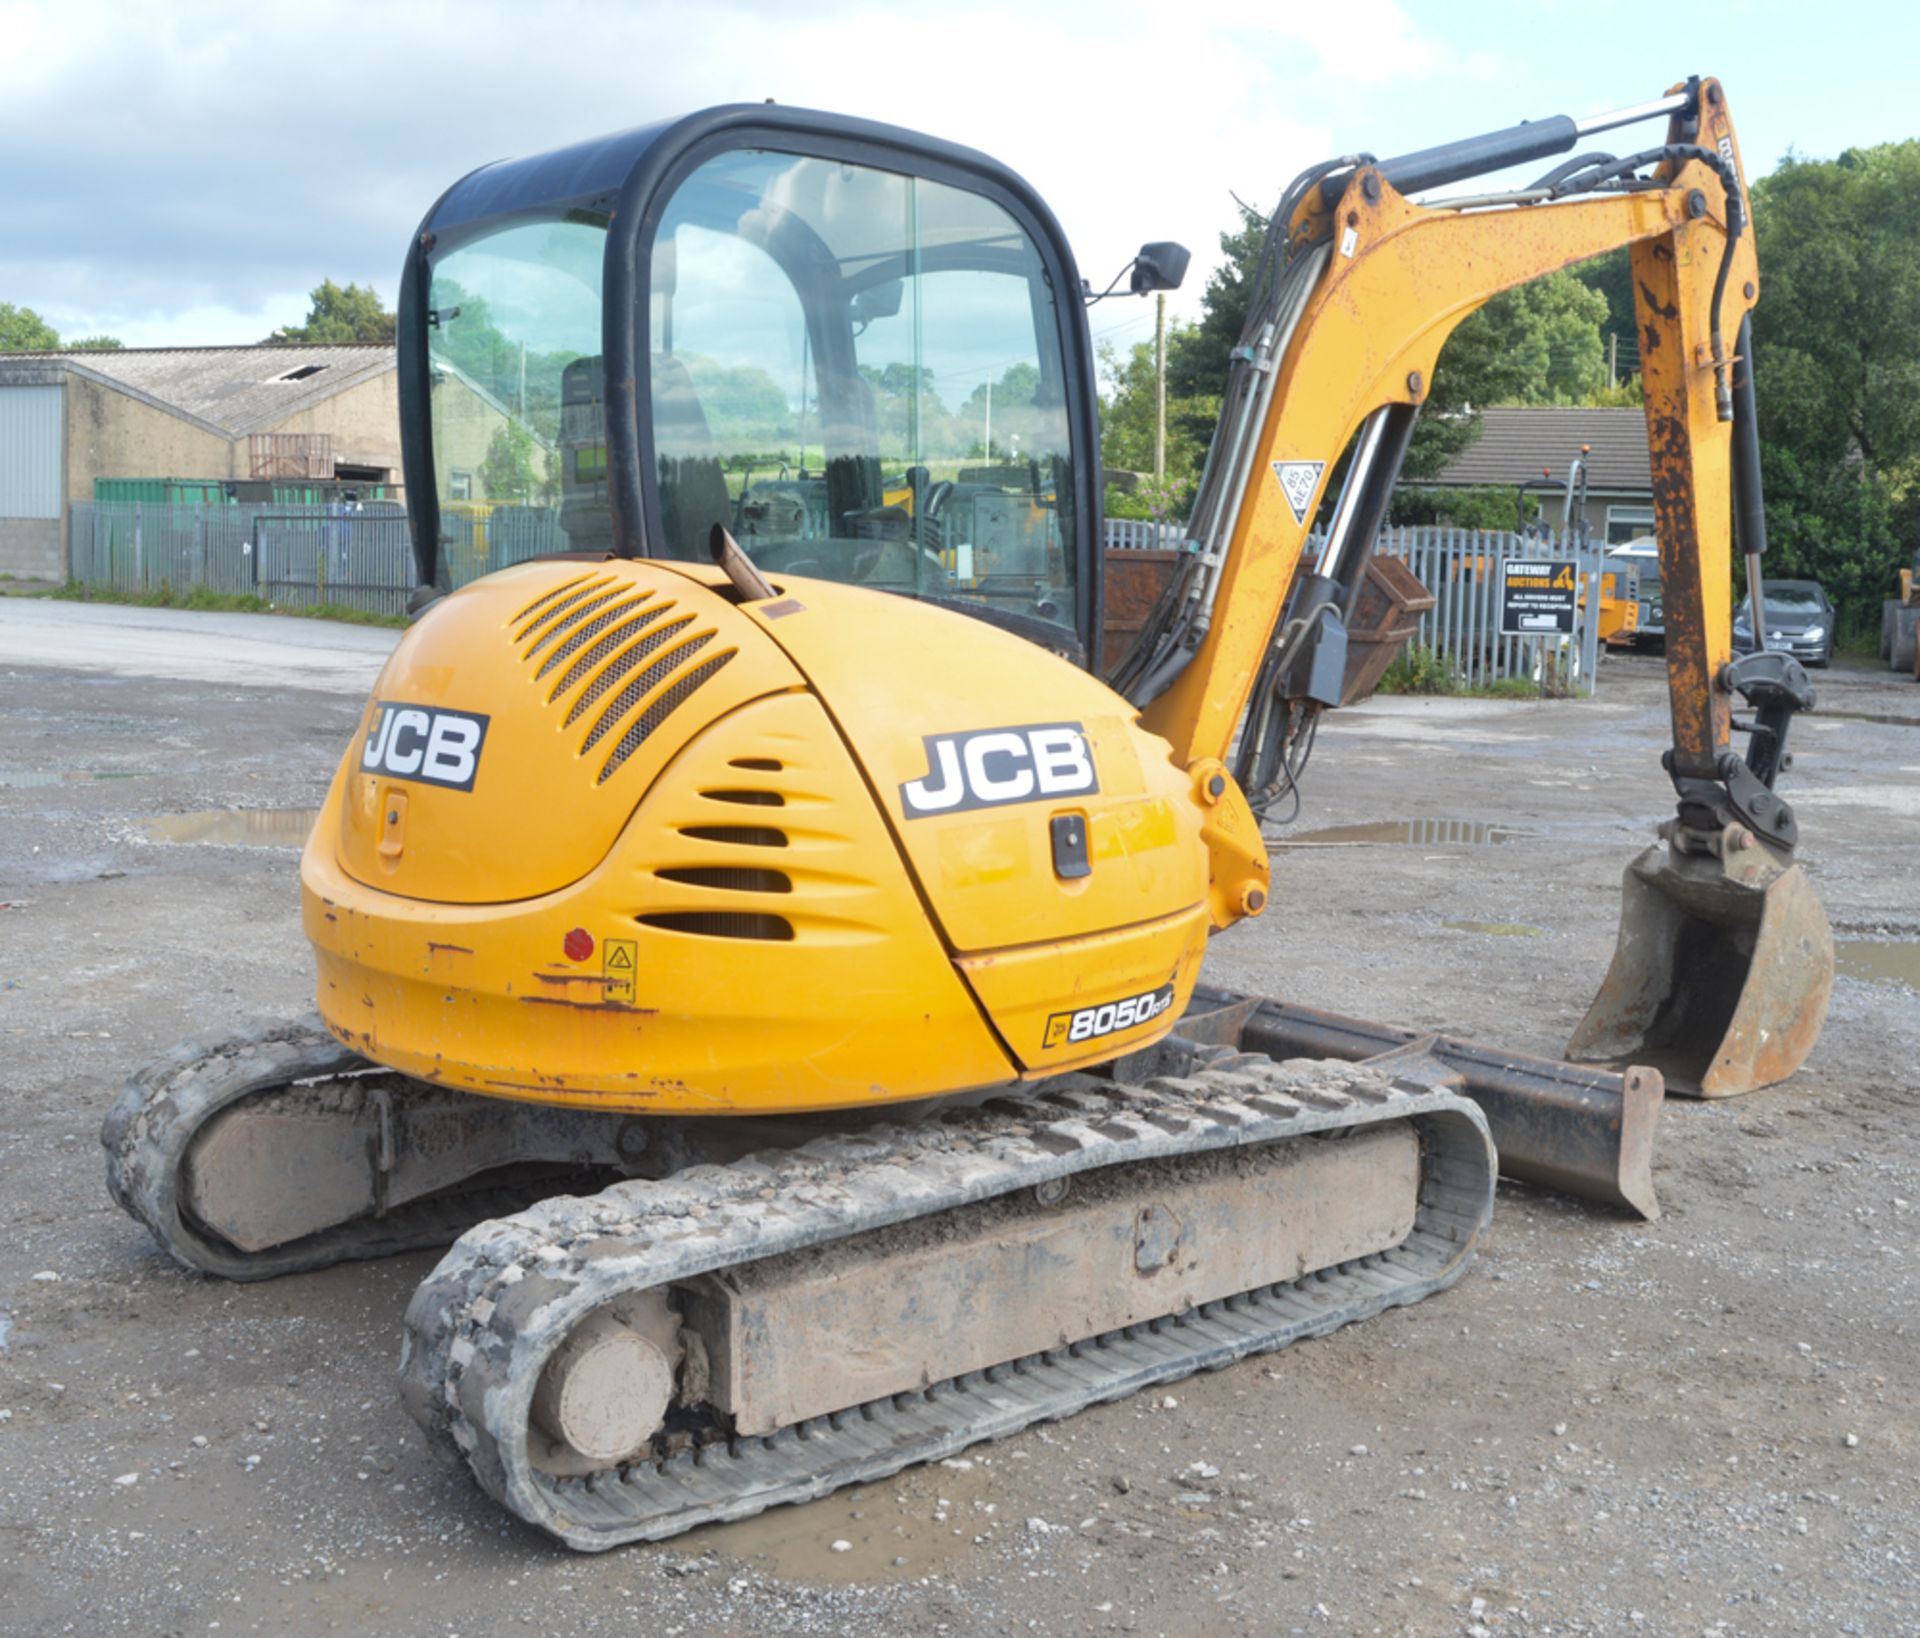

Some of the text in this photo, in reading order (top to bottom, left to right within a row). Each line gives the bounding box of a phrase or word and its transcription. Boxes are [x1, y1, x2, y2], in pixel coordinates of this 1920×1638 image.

[1506, 564, 1552, 575] GATEWAY
[1507, 577, 1551, 588] AUCTIONS
[363, 708, 481, 783] JCB
[905, 728, 1093, 811] JCB
